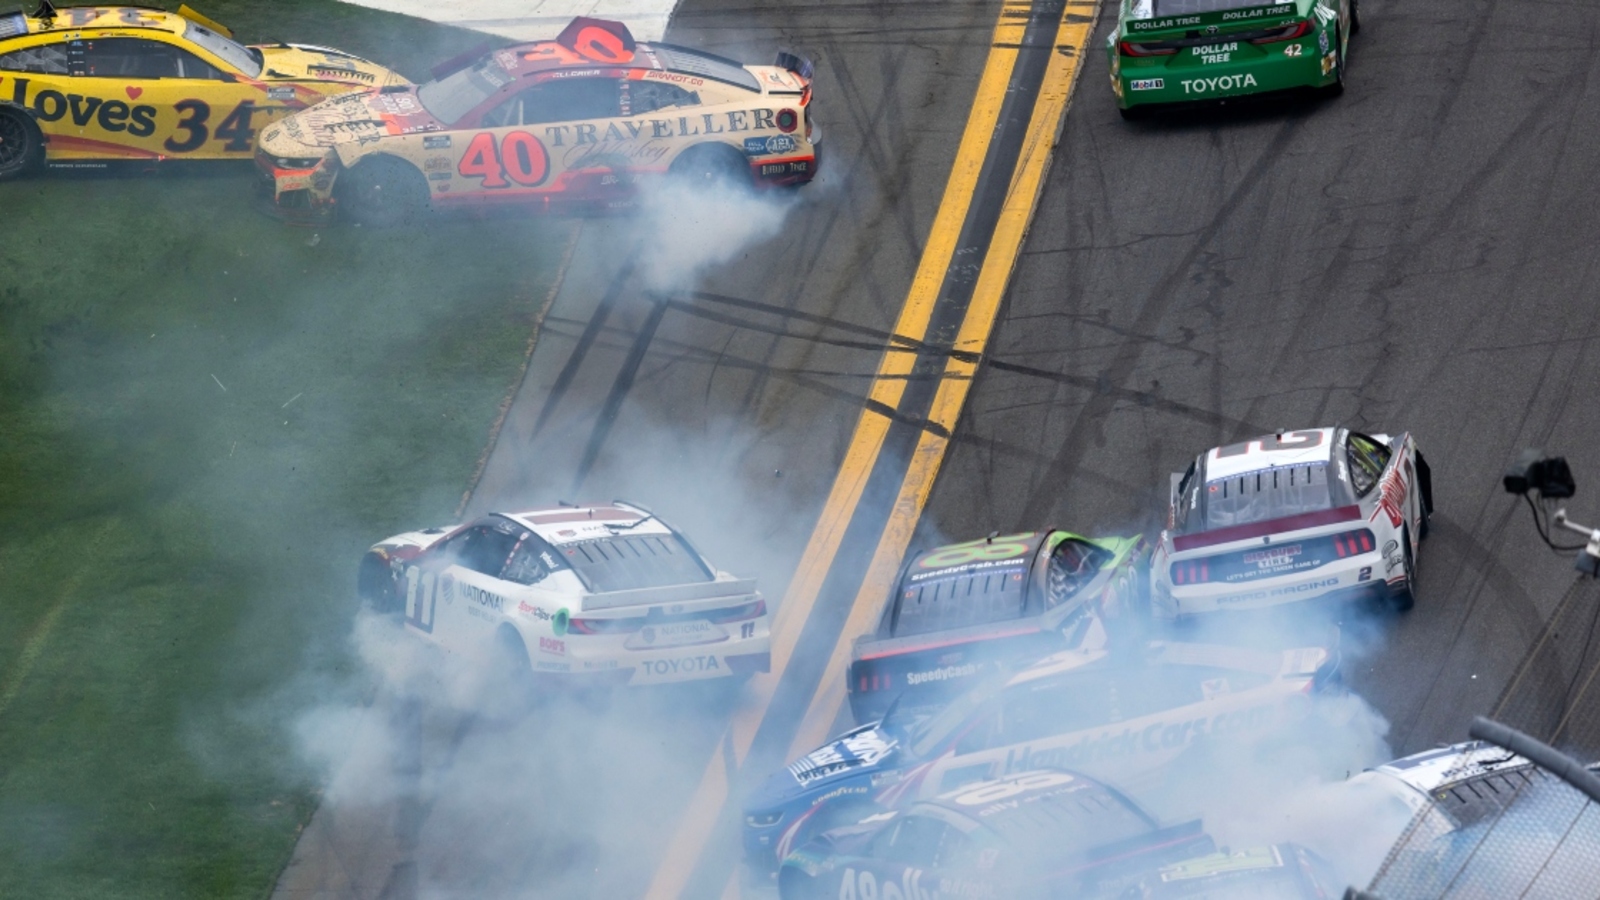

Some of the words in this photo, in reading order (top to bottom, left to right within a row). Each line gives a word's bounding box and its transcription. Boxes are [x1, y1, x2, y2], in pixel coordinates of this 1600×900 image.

[1220, 8, 1262, 21] DOLLAR
[1265, 4, 1291, 16] TREE
[1133, 19, 1174, 30] DOLLAR
[1175, 15, 1201, 26] TREE
[1191, 42, 1238, 56] DOLLAR
[1283, 43, 1302, 57] 42
[1200, 52, 1231, 65] TREE
[1181, 73, 1258, 94] TOYOTA
[164, 98, 256, 152] 34
[546, 107, 776, 147] TRAVELLER
[457, 131, 550, 187] 40
[1357, 566, 1371, 582] 2
[404, 563, 440, 634] 11
[1216, 591, 1271, 605] FORD
[1271, 577, 1339, 596] RACING
[661, 622, 711, 635] NATIONAL
[740, 621, 756, 639] 11
[539, 636, 566, 653] BOB'S
[641, 655, 720, 675] TOYOTA
[811, 786, 868, 806] GOODYEAR
